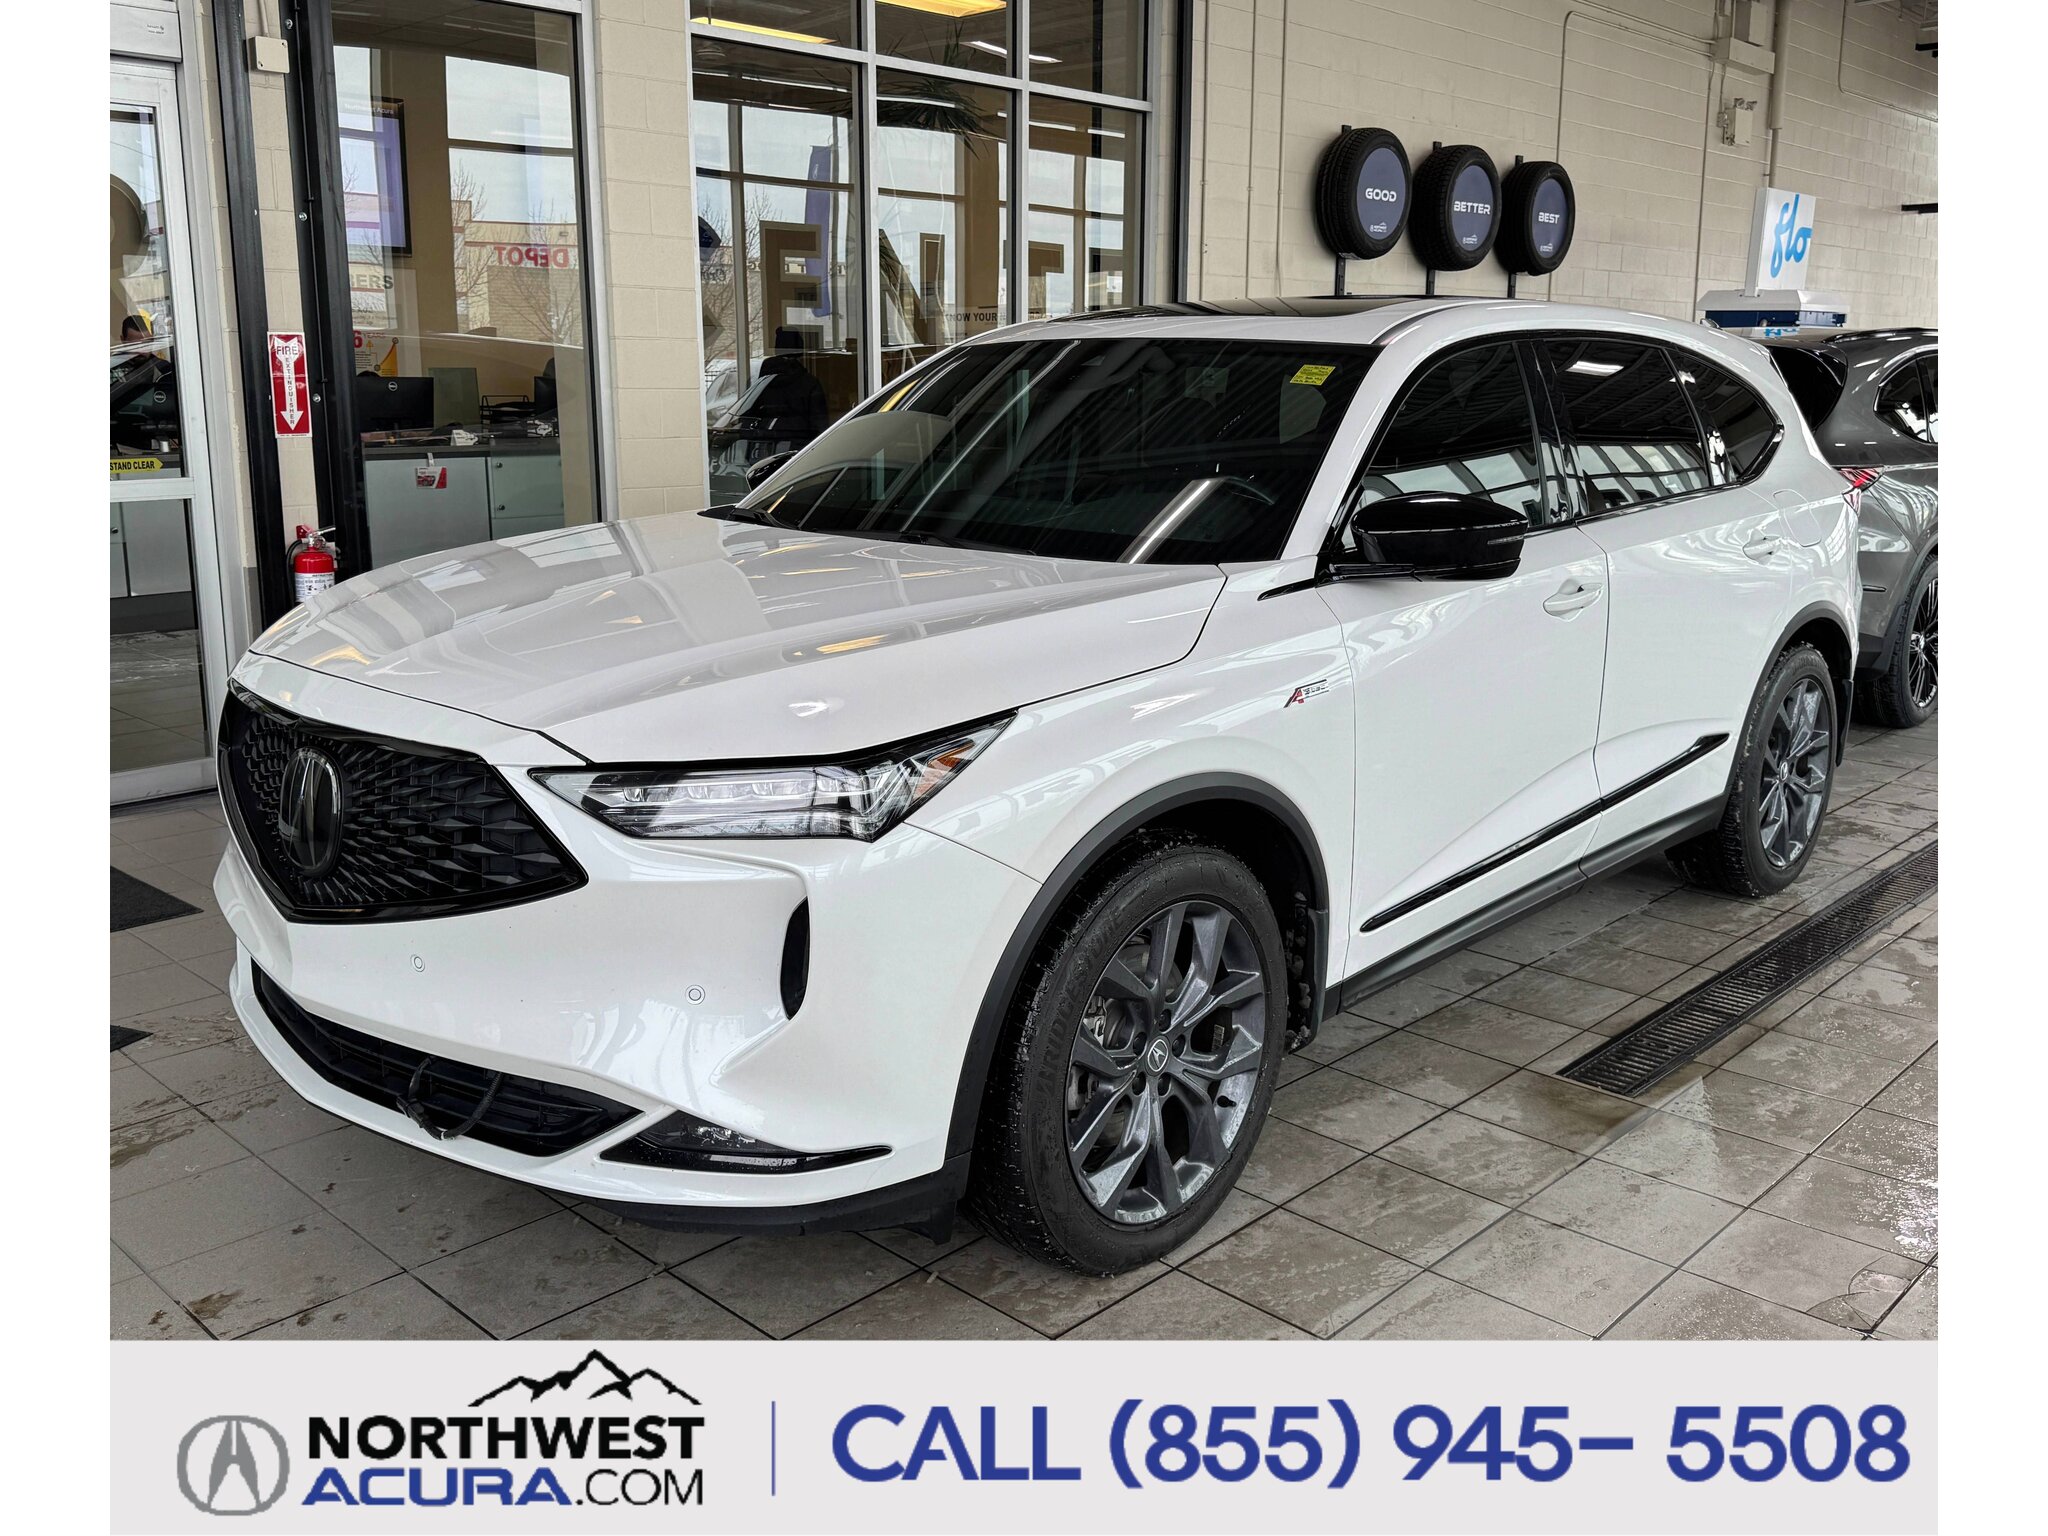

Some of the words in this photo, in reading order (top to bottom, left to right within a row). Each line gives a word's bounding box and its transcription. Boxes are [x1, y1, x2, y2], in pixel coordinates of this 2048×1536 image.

[1365, 188, 1397, 202] GOOD
[1454, 201, 1491, 215] BETTER
[1538, 212, 1560, 224] BEST
[1770, 194, 1813, 278] flo
[974, 312, 998, 322] YOUR
[276, 345, 299, 356] FIRE
[285, 357, 295, 425] EXTINGUISHER
[110, 462, 132, 471] STAND
[133, 461, 155, 470] CLEAR
